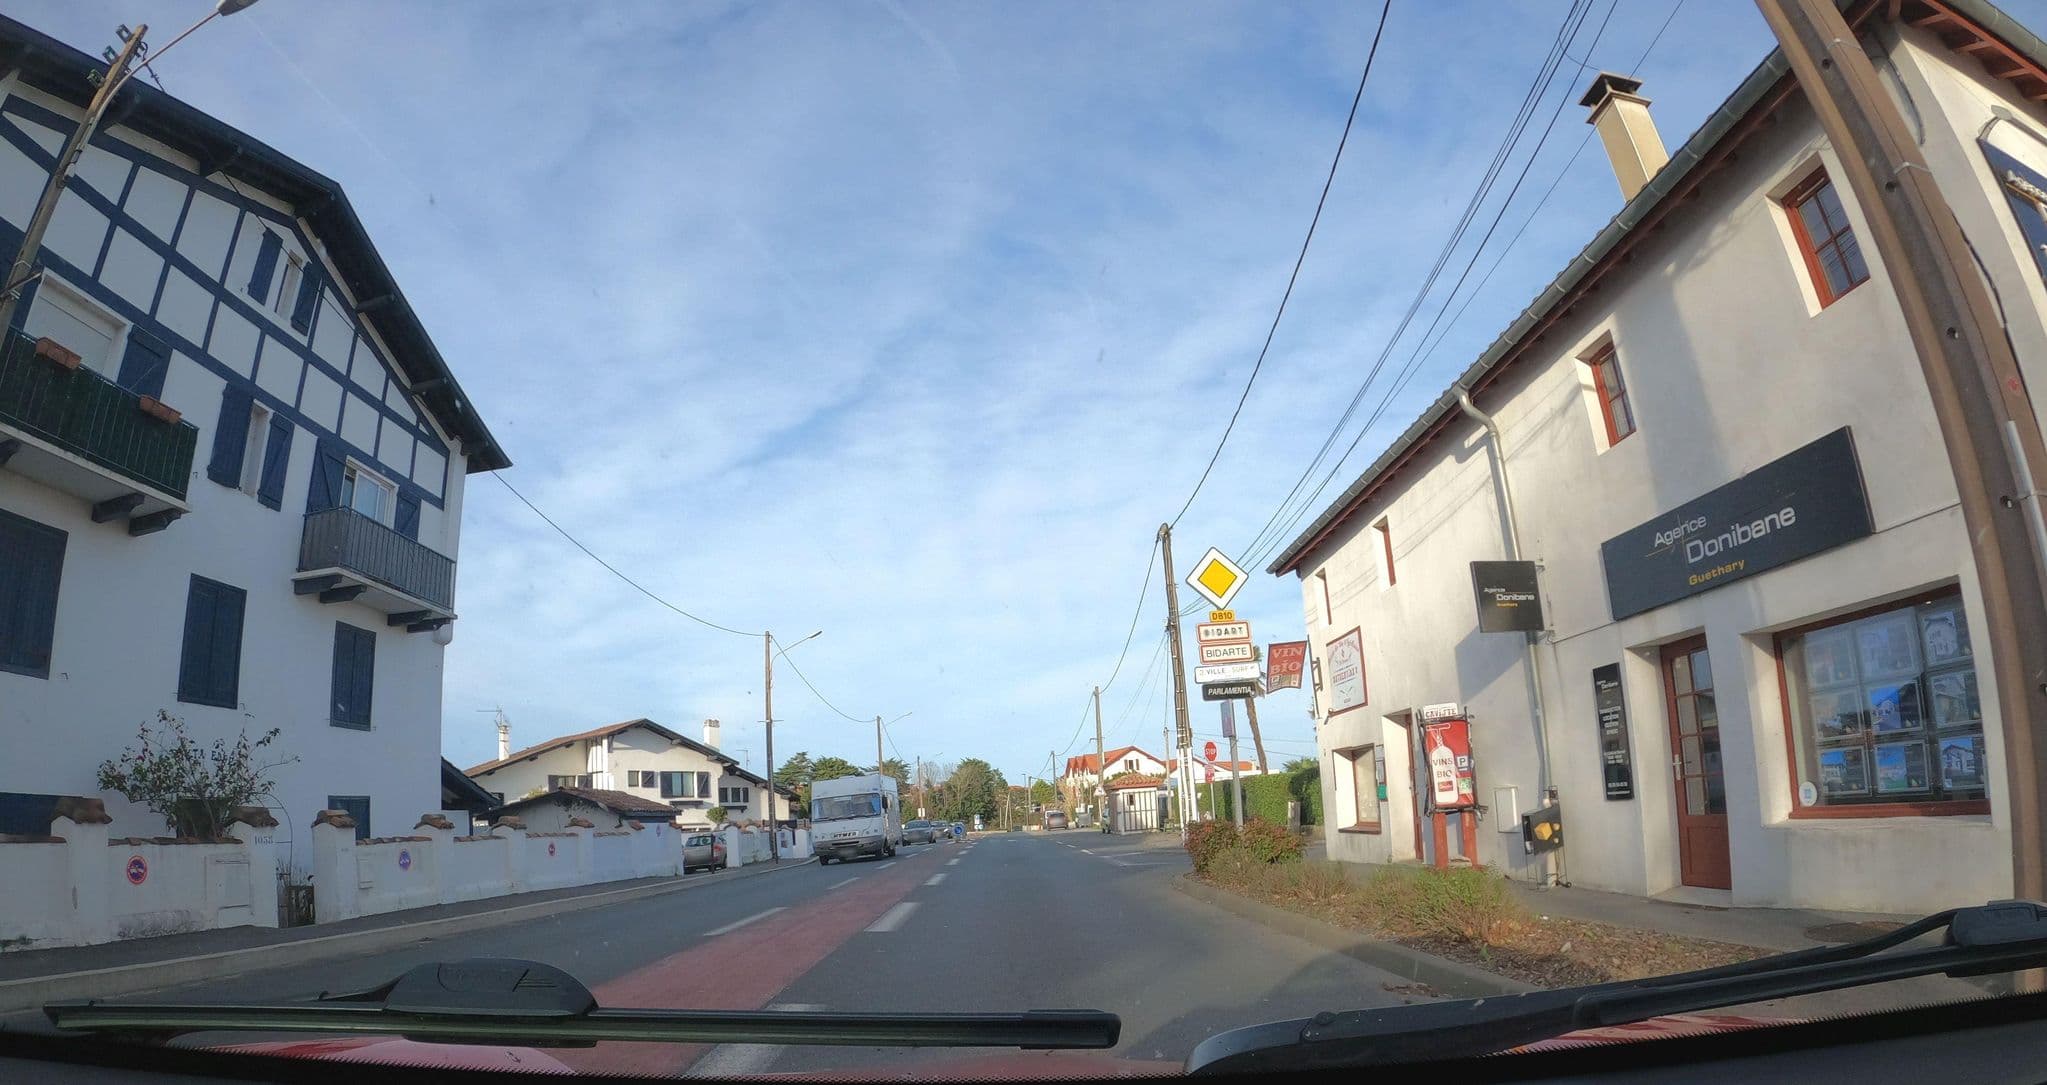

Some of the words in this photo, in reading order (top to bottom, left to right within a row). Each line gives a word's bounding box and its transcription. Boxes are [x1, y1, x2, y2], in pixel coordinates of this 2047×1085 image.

[1654, 515, 1707, 547] Agence
[1686, 506, 1796, 564] Donibane
[1689, 560, 1745, 585] Guethary
[1496, 593, 1535, 601] Donibane
[1203, 627, 1244, 637] BIDART
[1206, 647, 1248, 658] BIDARTE
[1272, 647, 1303, 658] VIN
[1205, 747, 1216, 755] STOP
[1432, 757, 1453, 766] VINS
[1459, 757, 1466, 765] P
